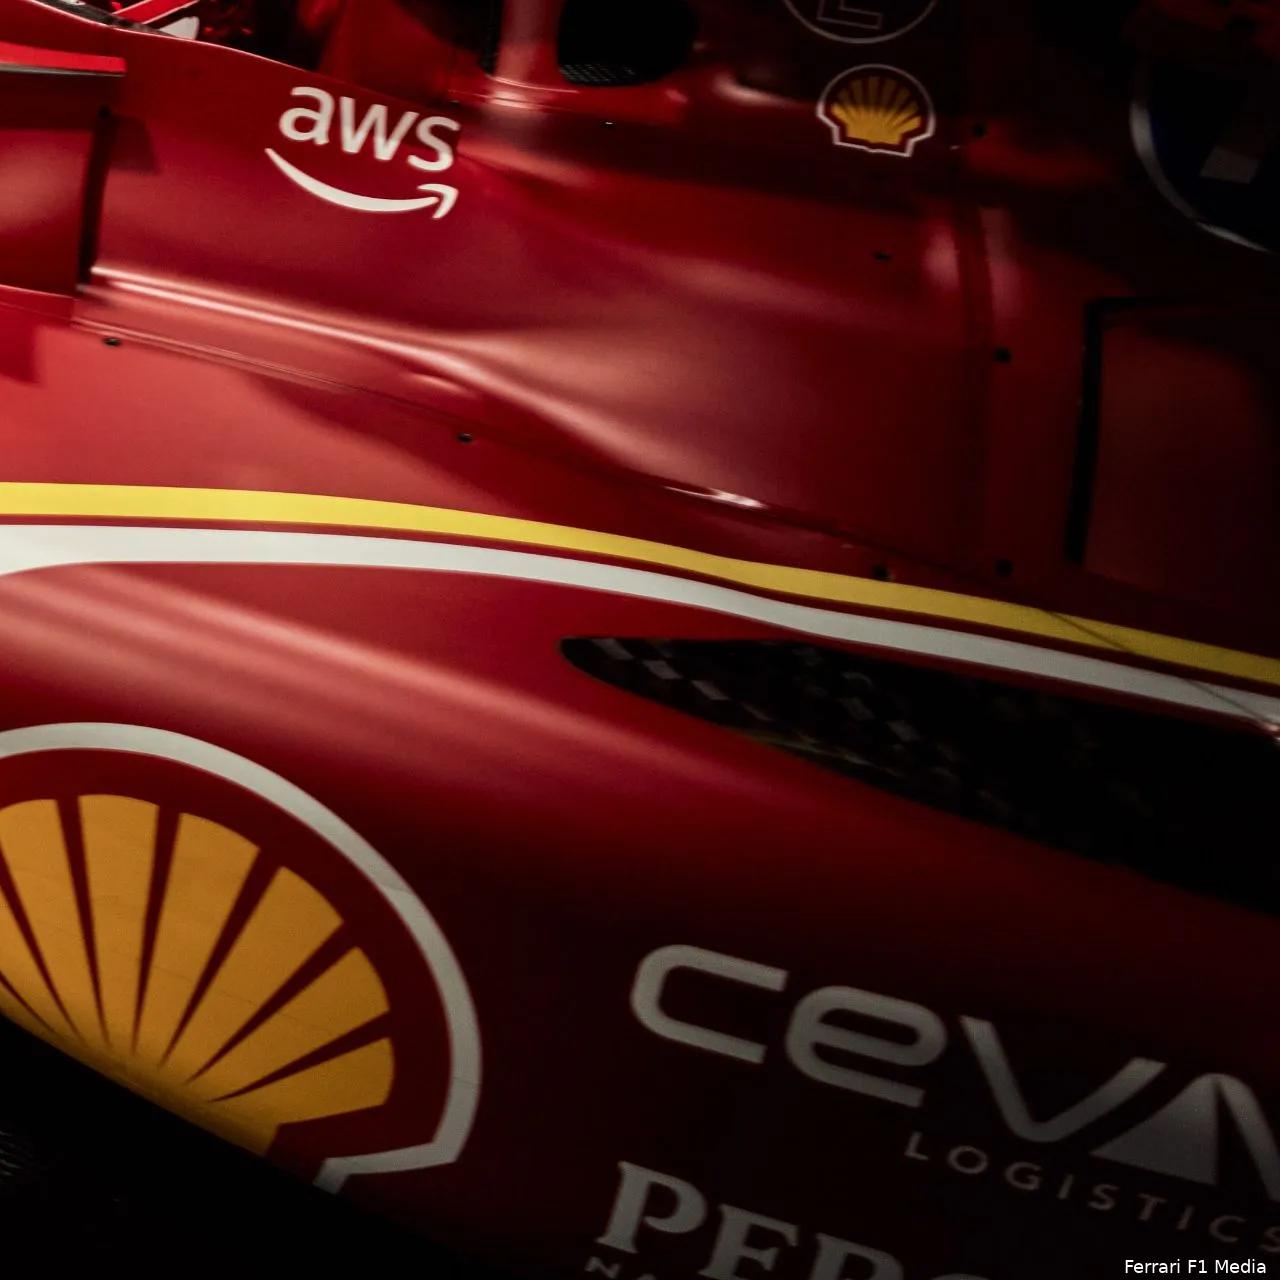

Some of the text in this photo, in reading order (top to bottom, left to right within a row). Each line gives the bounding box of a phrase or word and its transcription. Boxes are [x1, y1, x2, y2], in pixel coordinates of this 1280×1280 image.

[278, 86, 461, 172] aws
[630, 944, 1280, 1206] CEVA
[598, 1157, 1000, 1280] PER
[903, 1131, 1280, 1252] LOGISTICS
